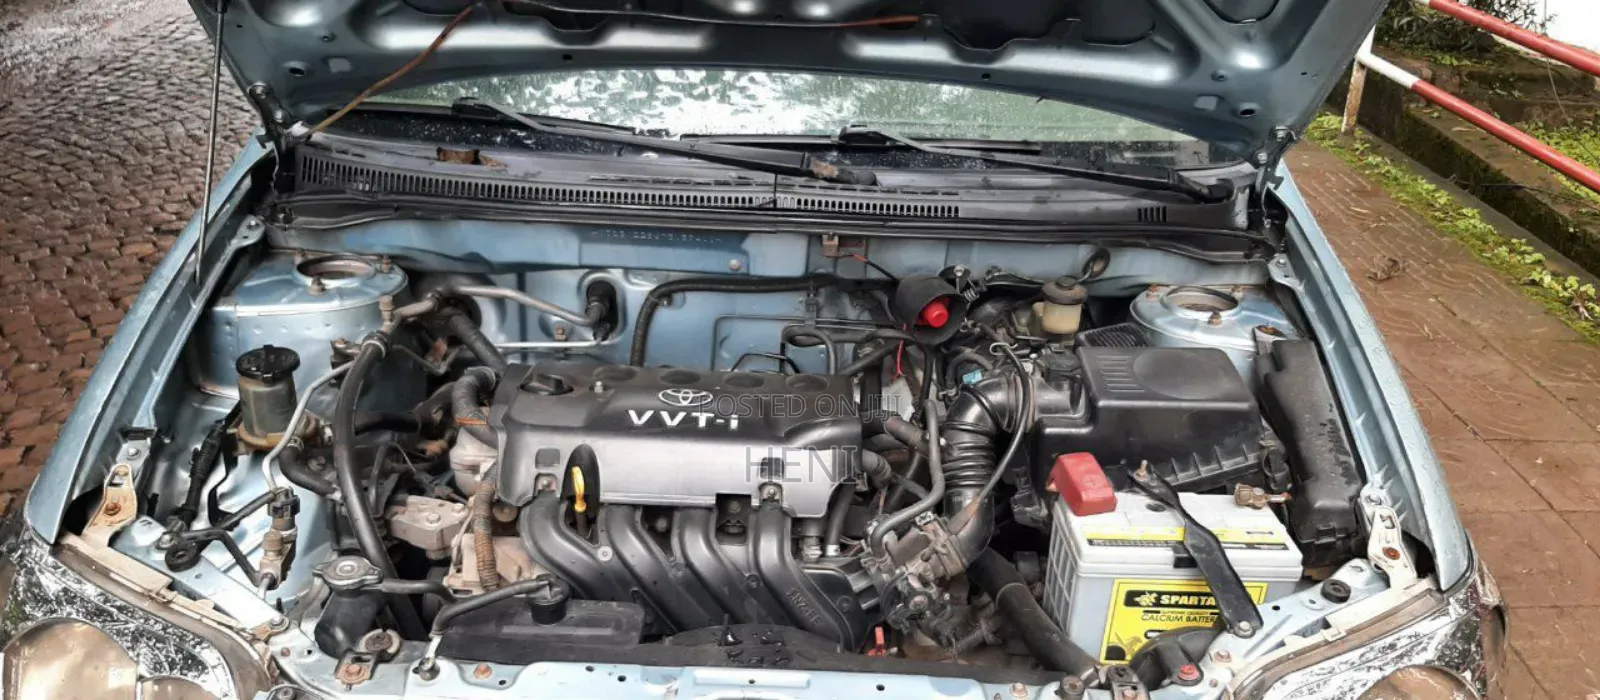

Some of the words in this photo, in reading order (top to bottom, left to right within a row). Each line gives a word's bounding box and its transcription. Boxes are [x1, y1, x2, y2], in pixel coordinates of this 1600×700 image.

[628, 409, 739, 430] VVT-i
[1159, 595, 1216, 606] SPARTA
[1141, 613, 1183, 622] CALCIUM
[1186, 614, 1218, 623] BATTER
